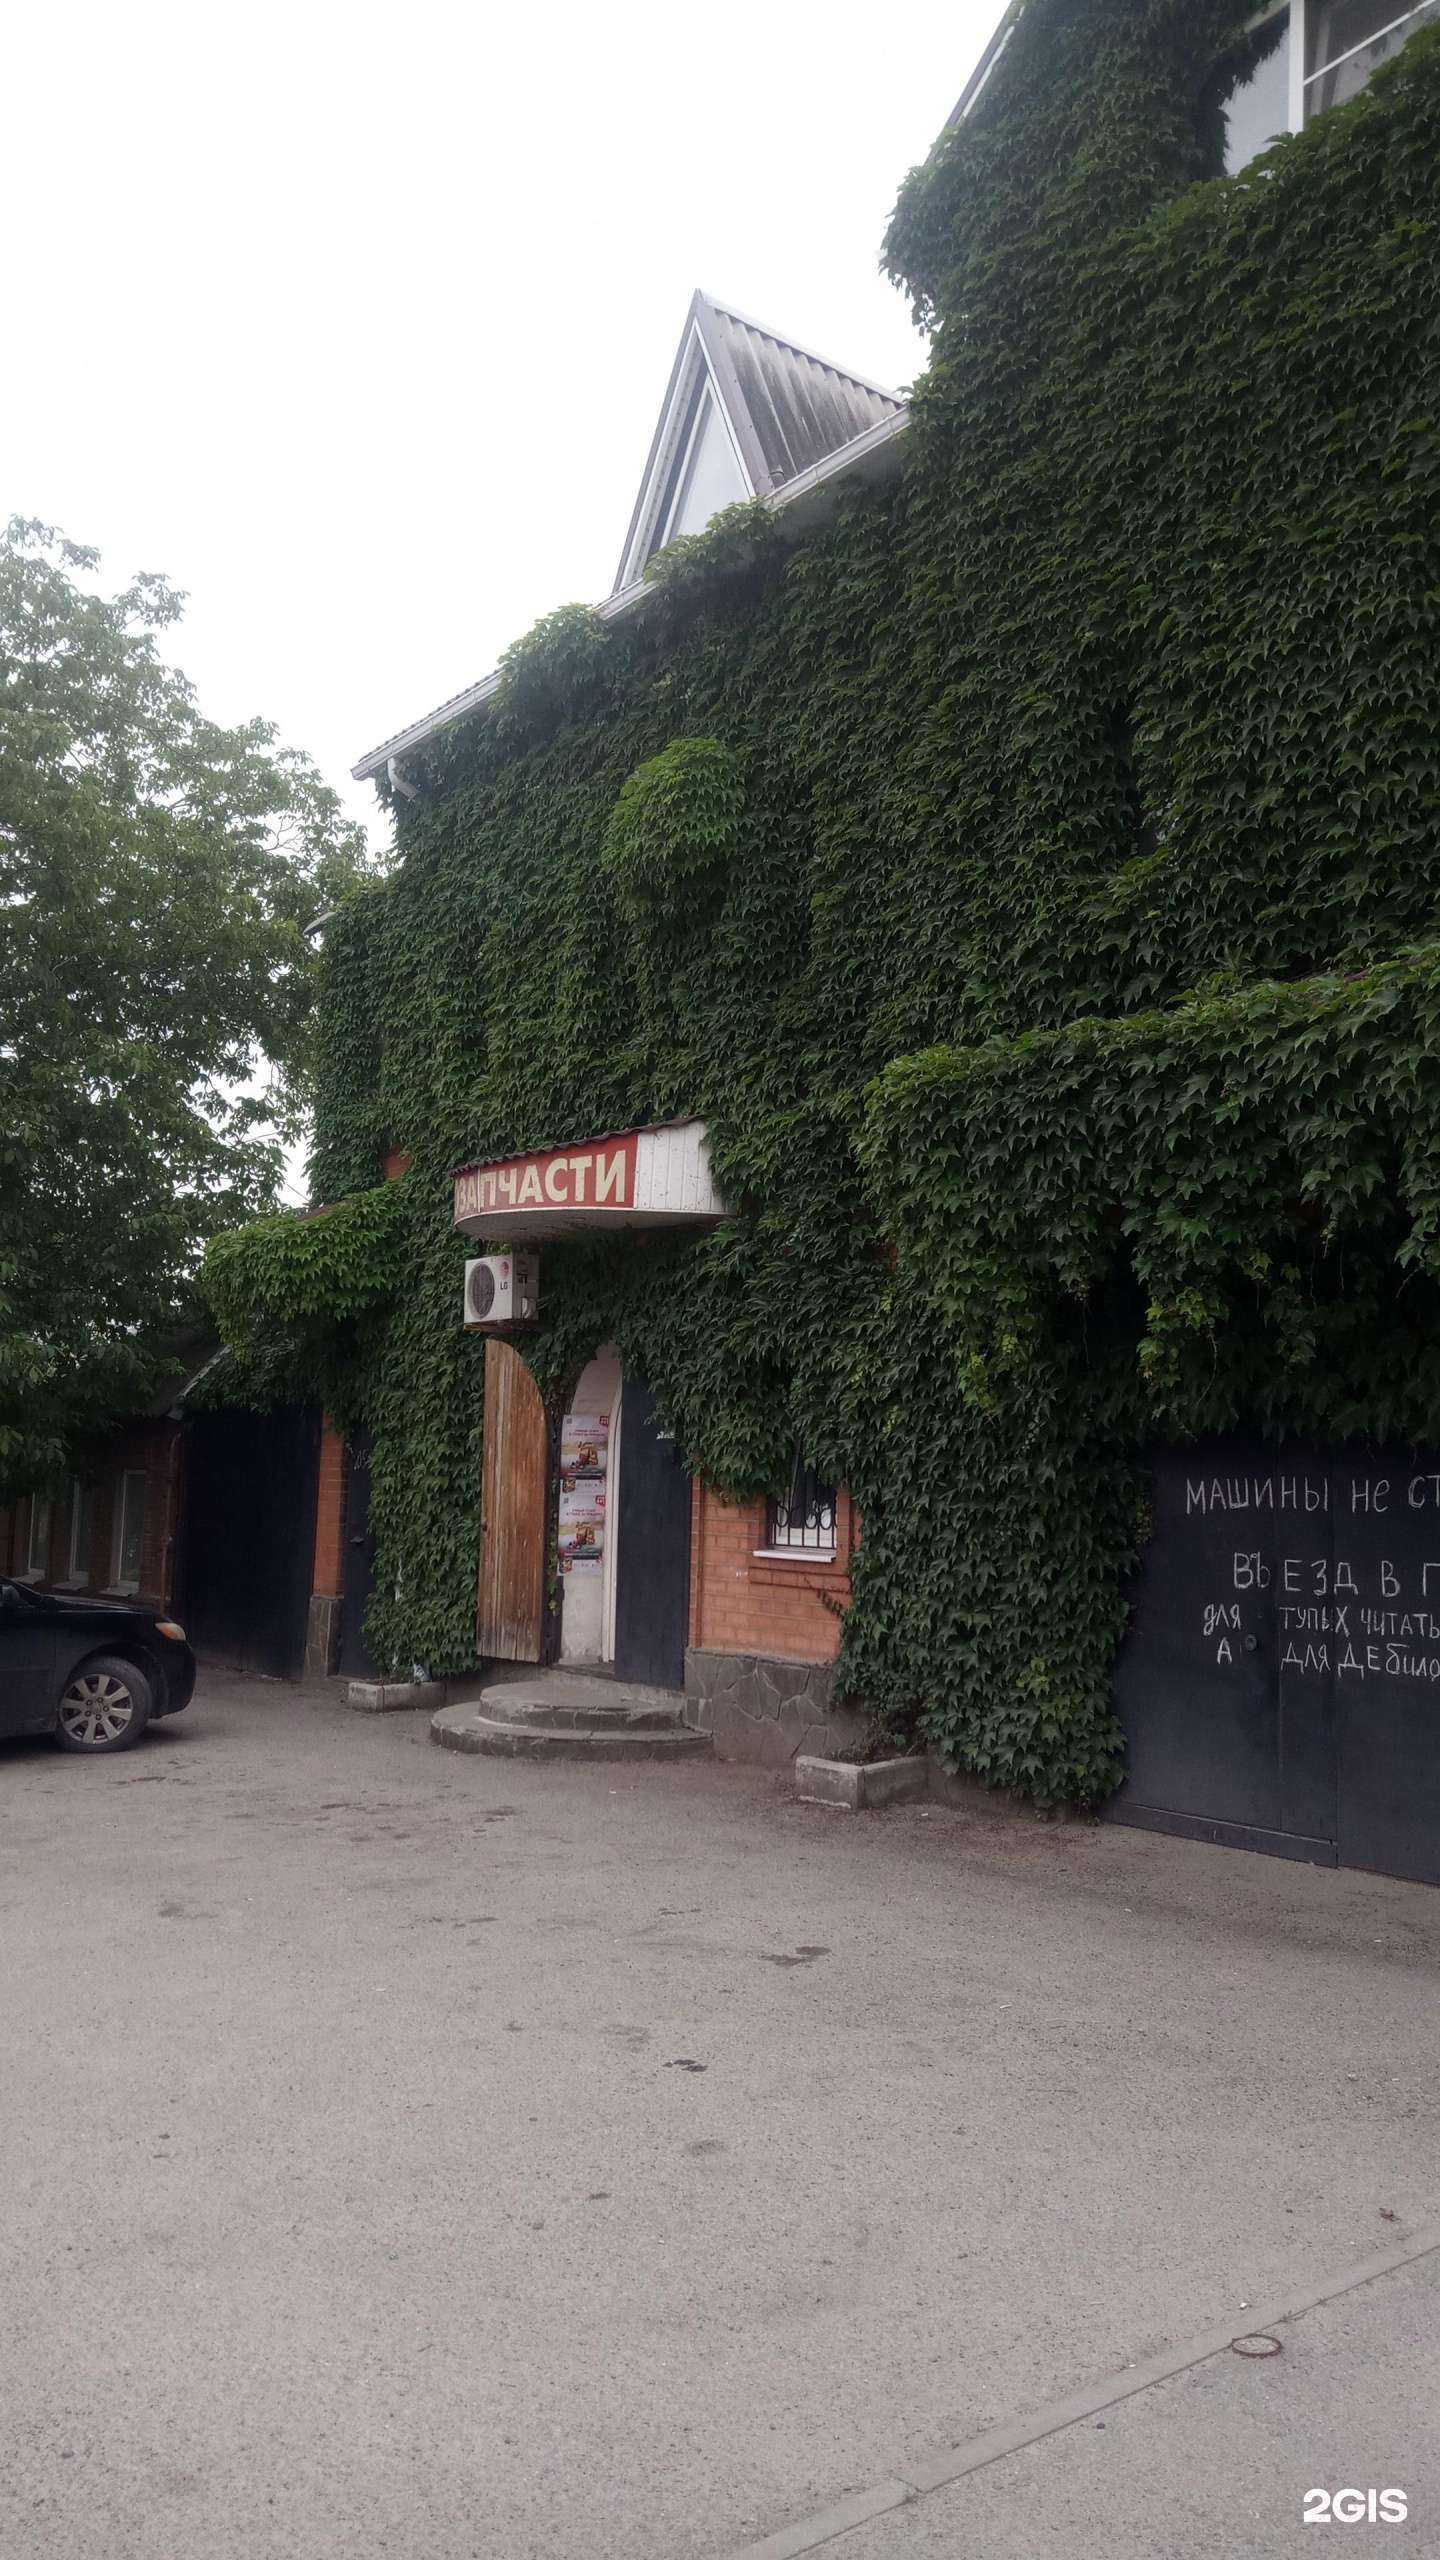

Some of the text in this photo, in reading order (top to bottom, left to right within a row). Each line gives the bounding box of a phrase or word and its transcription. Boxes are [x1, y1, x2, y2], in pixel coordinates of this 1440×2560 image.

[499, 1281, 509, 1291] LG
[1186, 1476, 1329, 1515] МАШИНЫ
[1361, 1607, 1440, 1638] ЧИТАТЬ
[1217, 1637, 1233, 1665] А
[1281, 1641, 1333, 1674] ДЛЯ
